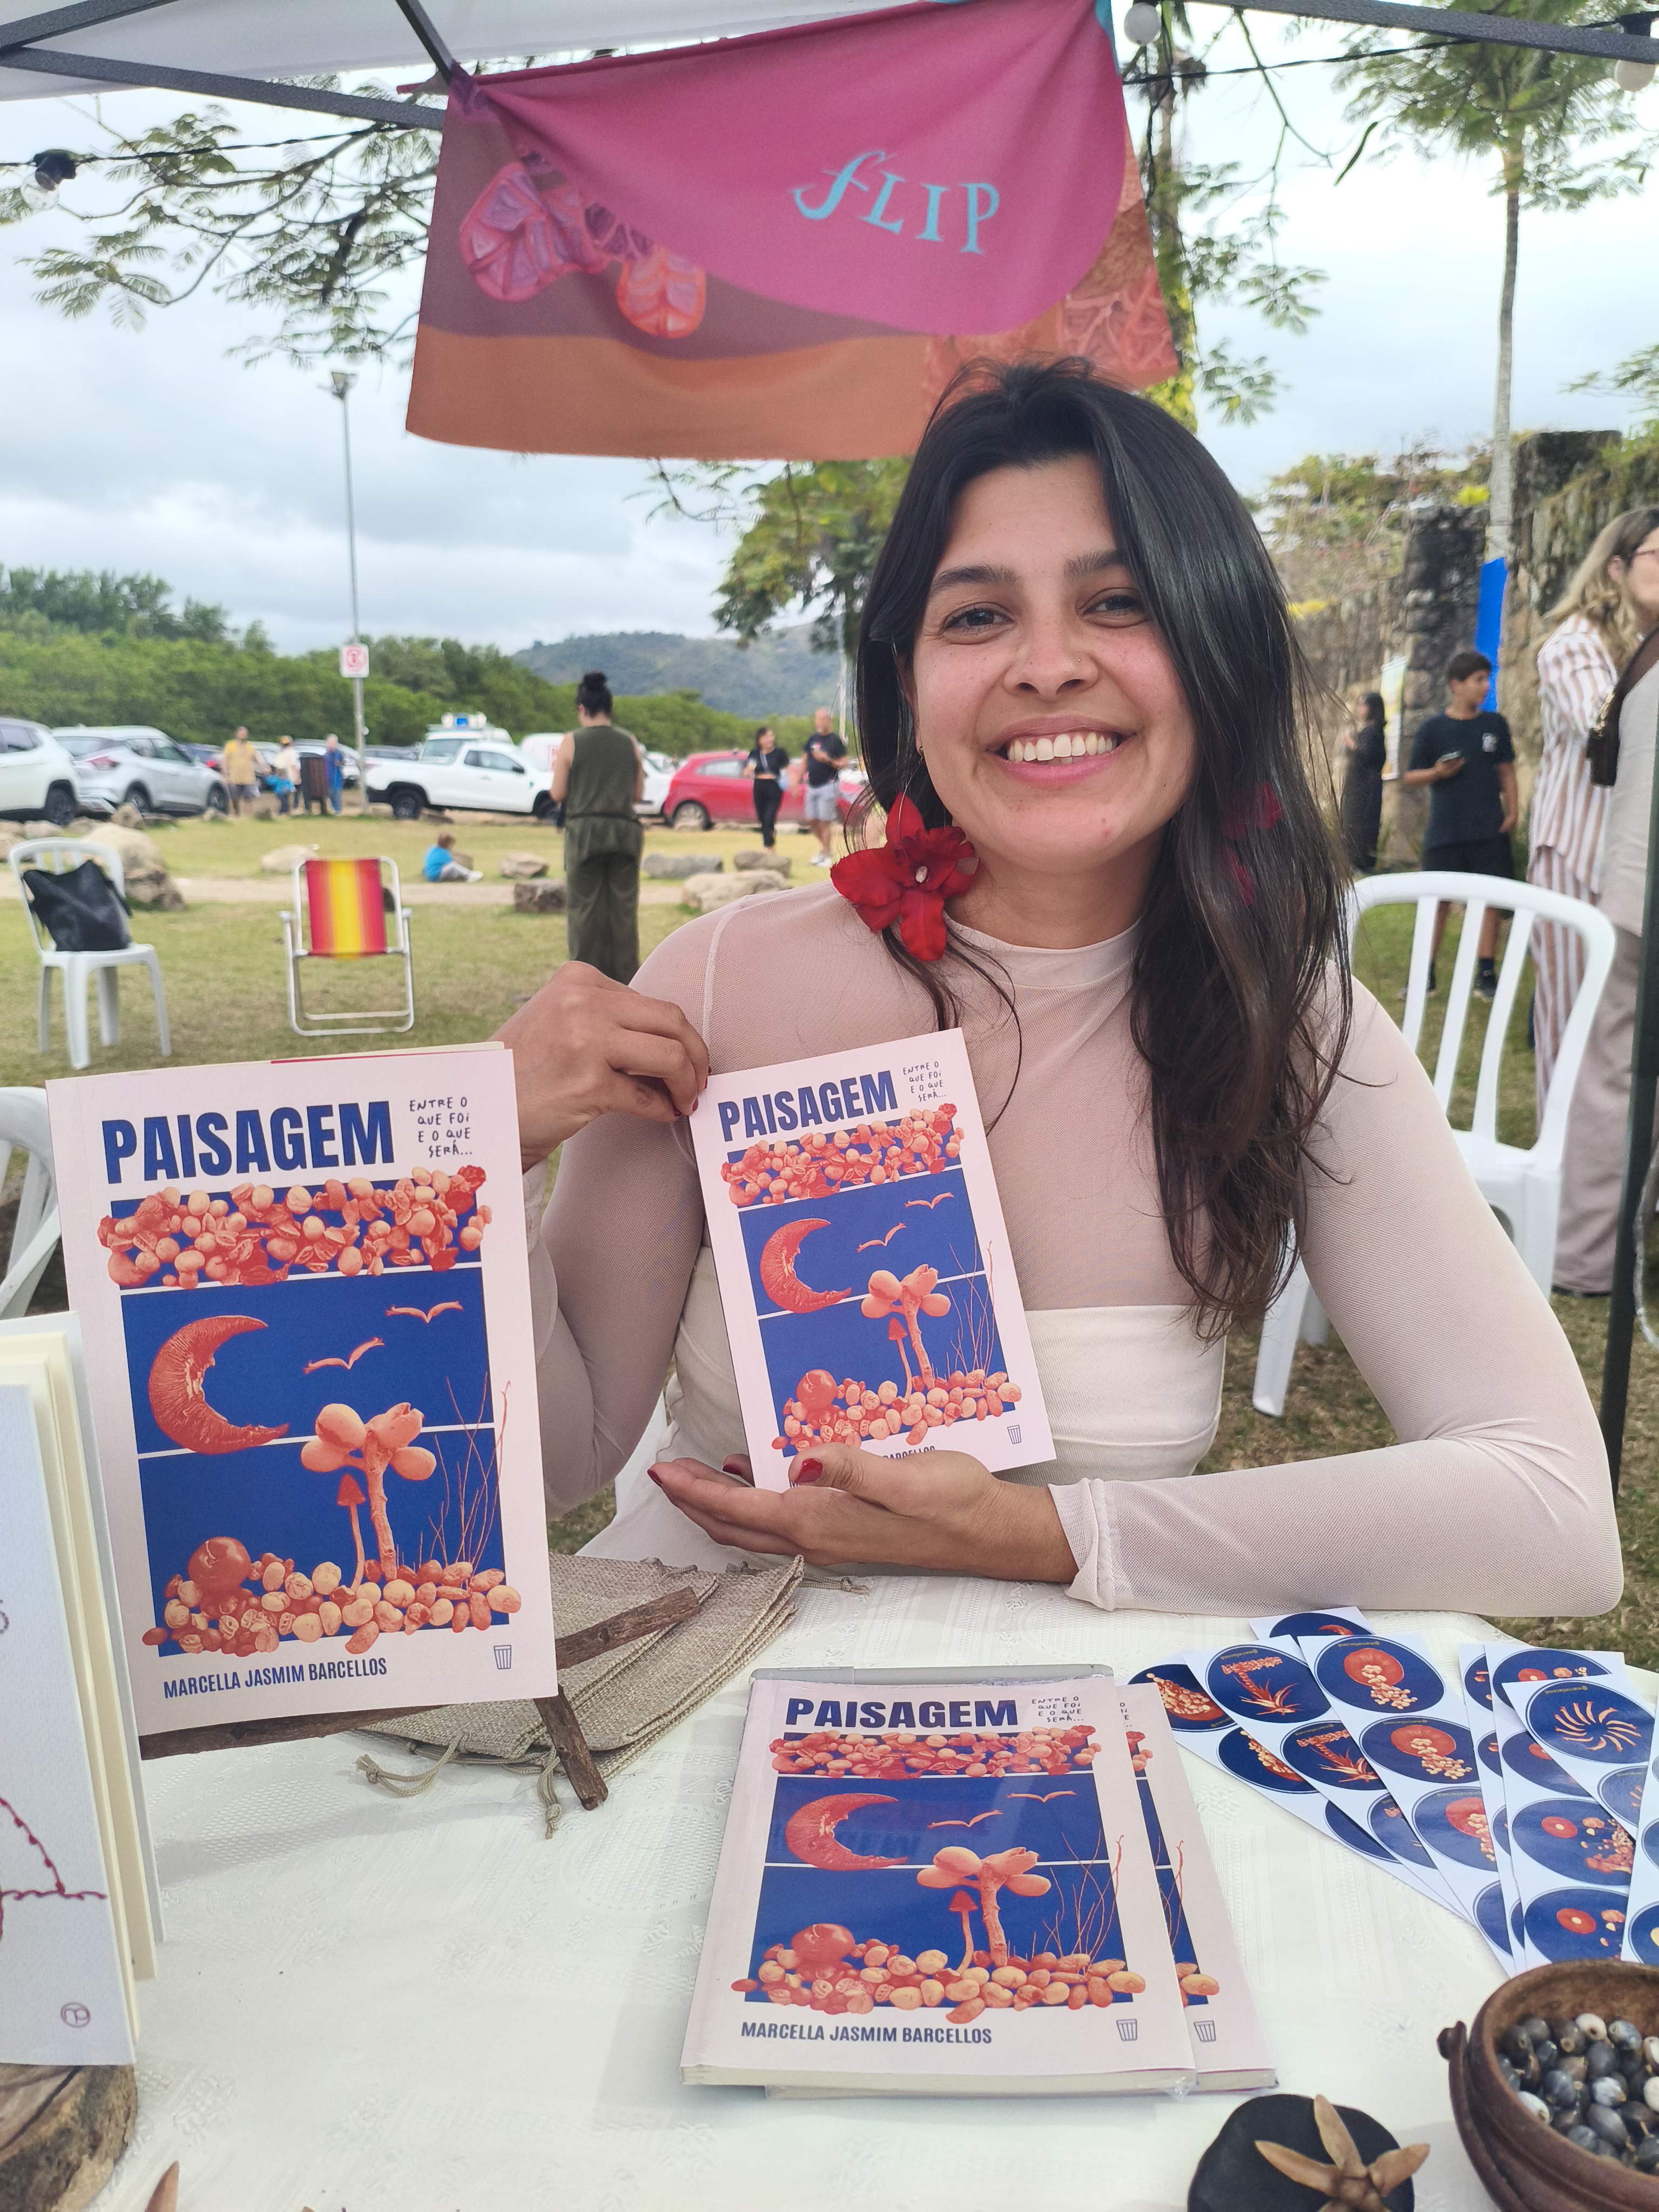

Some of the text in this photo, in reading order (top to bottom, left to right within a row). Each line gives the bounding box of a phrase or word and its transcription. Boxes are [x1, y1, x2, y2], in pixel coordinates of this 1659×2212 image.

[903, 1062, 930, 1075] ENTRE
[909, 1074, 924, 1082] QUE
[911, 1085, 915, 1094] E
[928, 1080, 943, 1088] QUE
[409, 1096, 468, 1112] ENTRE O
[718, 1070, 898, 1142] PAISAGEM
[417, 1113, 442, 1125] QUE
[102, 1101, 395, 1184] PAISAGEM
[418, 1127, 471, 1143] E O QUE
[163, 1657, 388, 1698] MARCELLA JASMIM BARCELLOS
[785, 1698, 1018, 1729] PAISAGEM
[741, 2021, 993, 2045] MARCELLA JASMIM BARCELLOS
